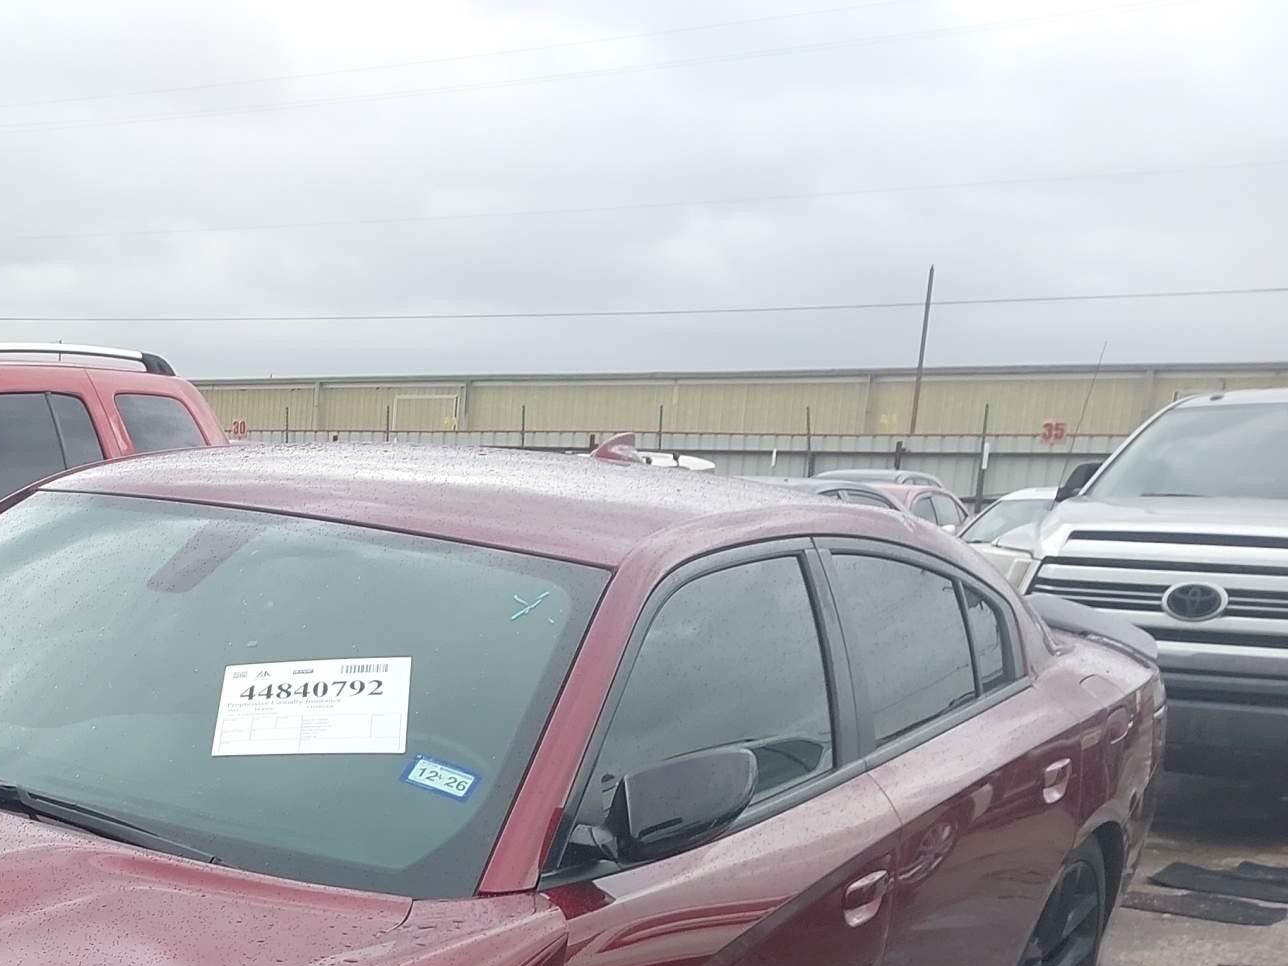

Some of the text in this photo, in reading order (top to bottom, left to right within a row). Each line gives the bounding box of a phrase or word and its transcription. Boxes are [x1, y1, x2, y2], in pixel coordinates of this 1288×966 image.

[232, 420, 246, 435] 30
[1042, 422, 1065, 441] 35
[239, 680, 384, 701] 44840792
